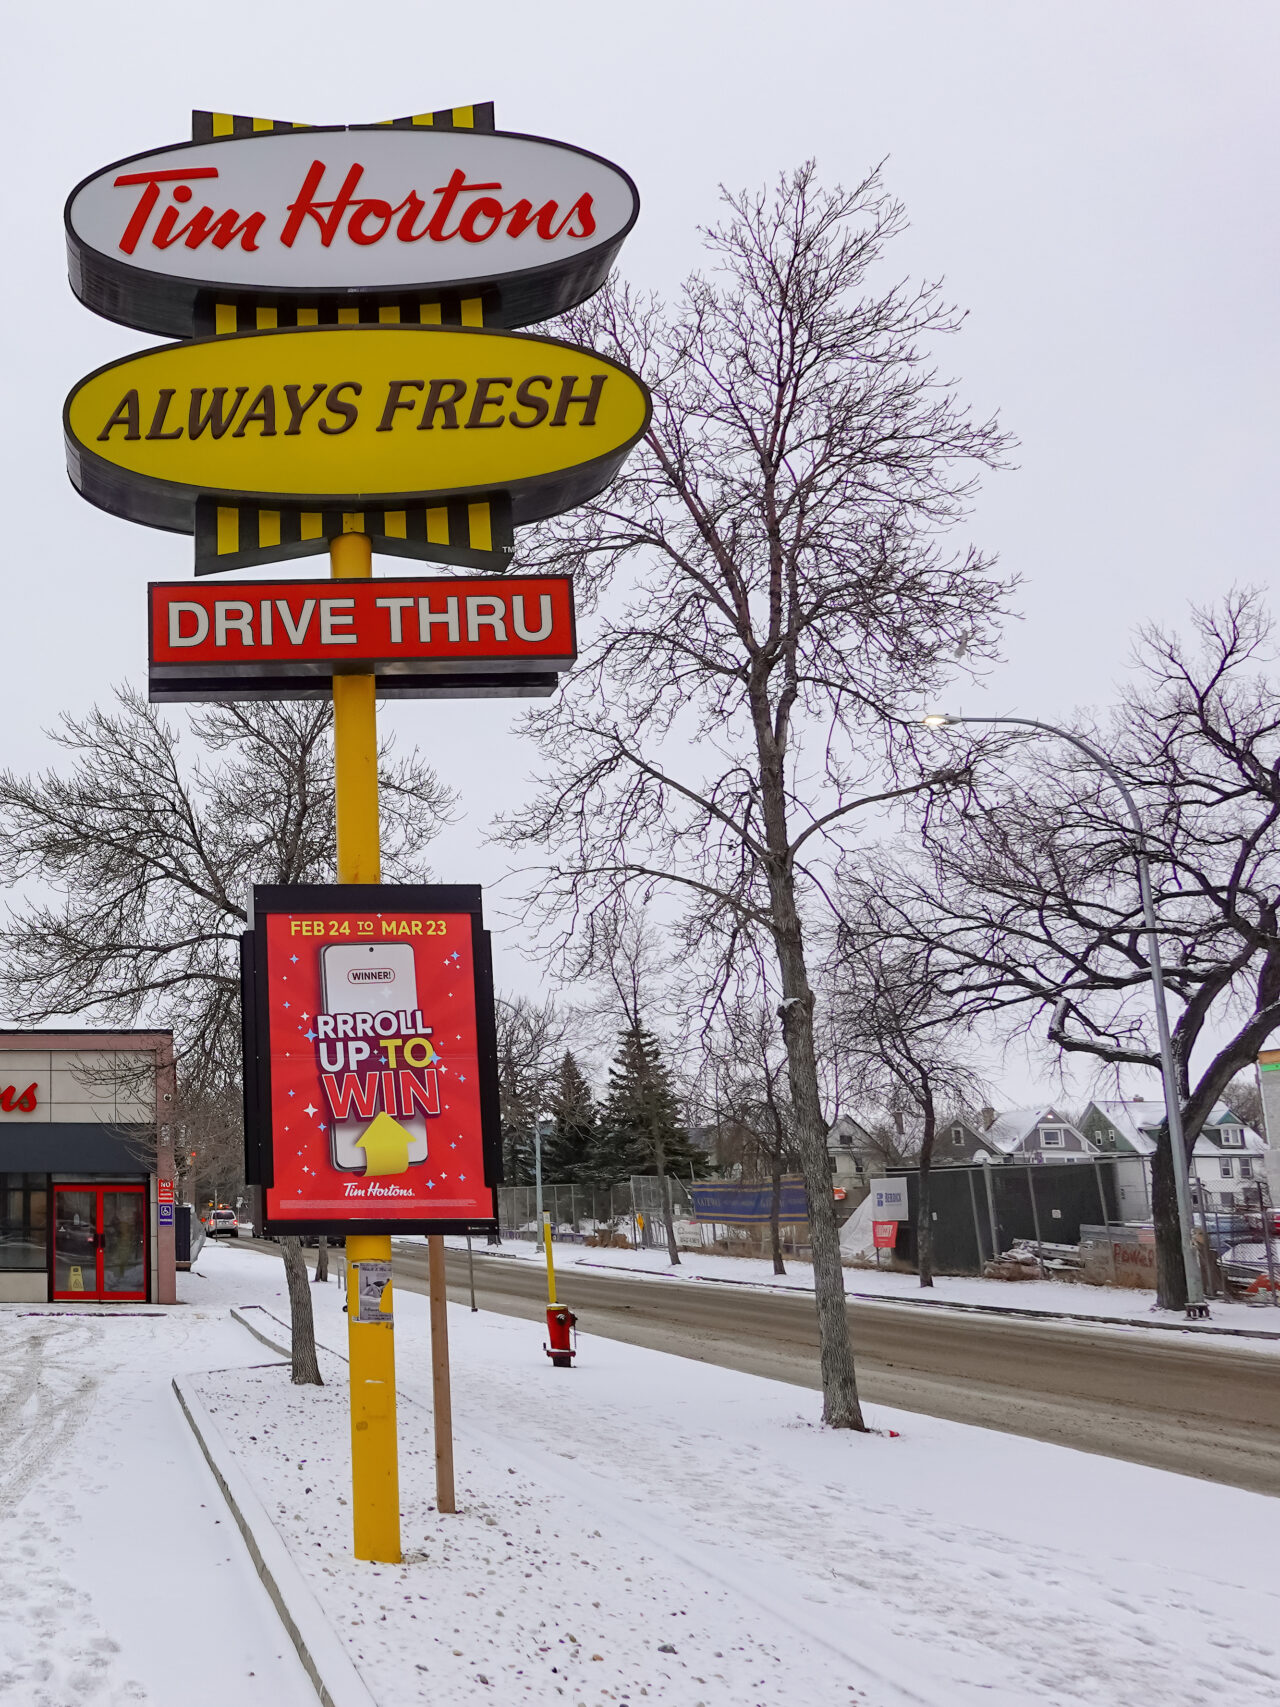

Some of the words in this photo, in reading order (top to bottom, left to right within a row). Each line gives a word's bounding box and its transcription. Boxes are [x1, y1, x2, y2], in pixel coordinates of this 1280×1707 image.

[113, 167, 267, 255] Tim
[280, 159, 597, 248] Hortons
[96, 382, 362, 441] ALWAYS
[375, 374, 608, 432] FRESH
[167, 598, 358, 647] DRIVE
[376, 594, 554, 643] THRU
[290, 921, 325, 936] FEB
[329, 921, 351, 935] 24
[357, 921, 374, 931] TO
[382, 921, 423, 935] MAR
[426, 921, 447, 935] 23
[352, 971, 391, 981] WINNER!
[317, 1010, 432, 1039] RRROLL
[319, 1042, 371, 1072] UP
[380, 1038, 434, 1069] TO
[322, 1069, 442, 1119] WIN
[343, 1182, 365, 1197] Tim
[367, 1182, 413, 1197] Hortons
